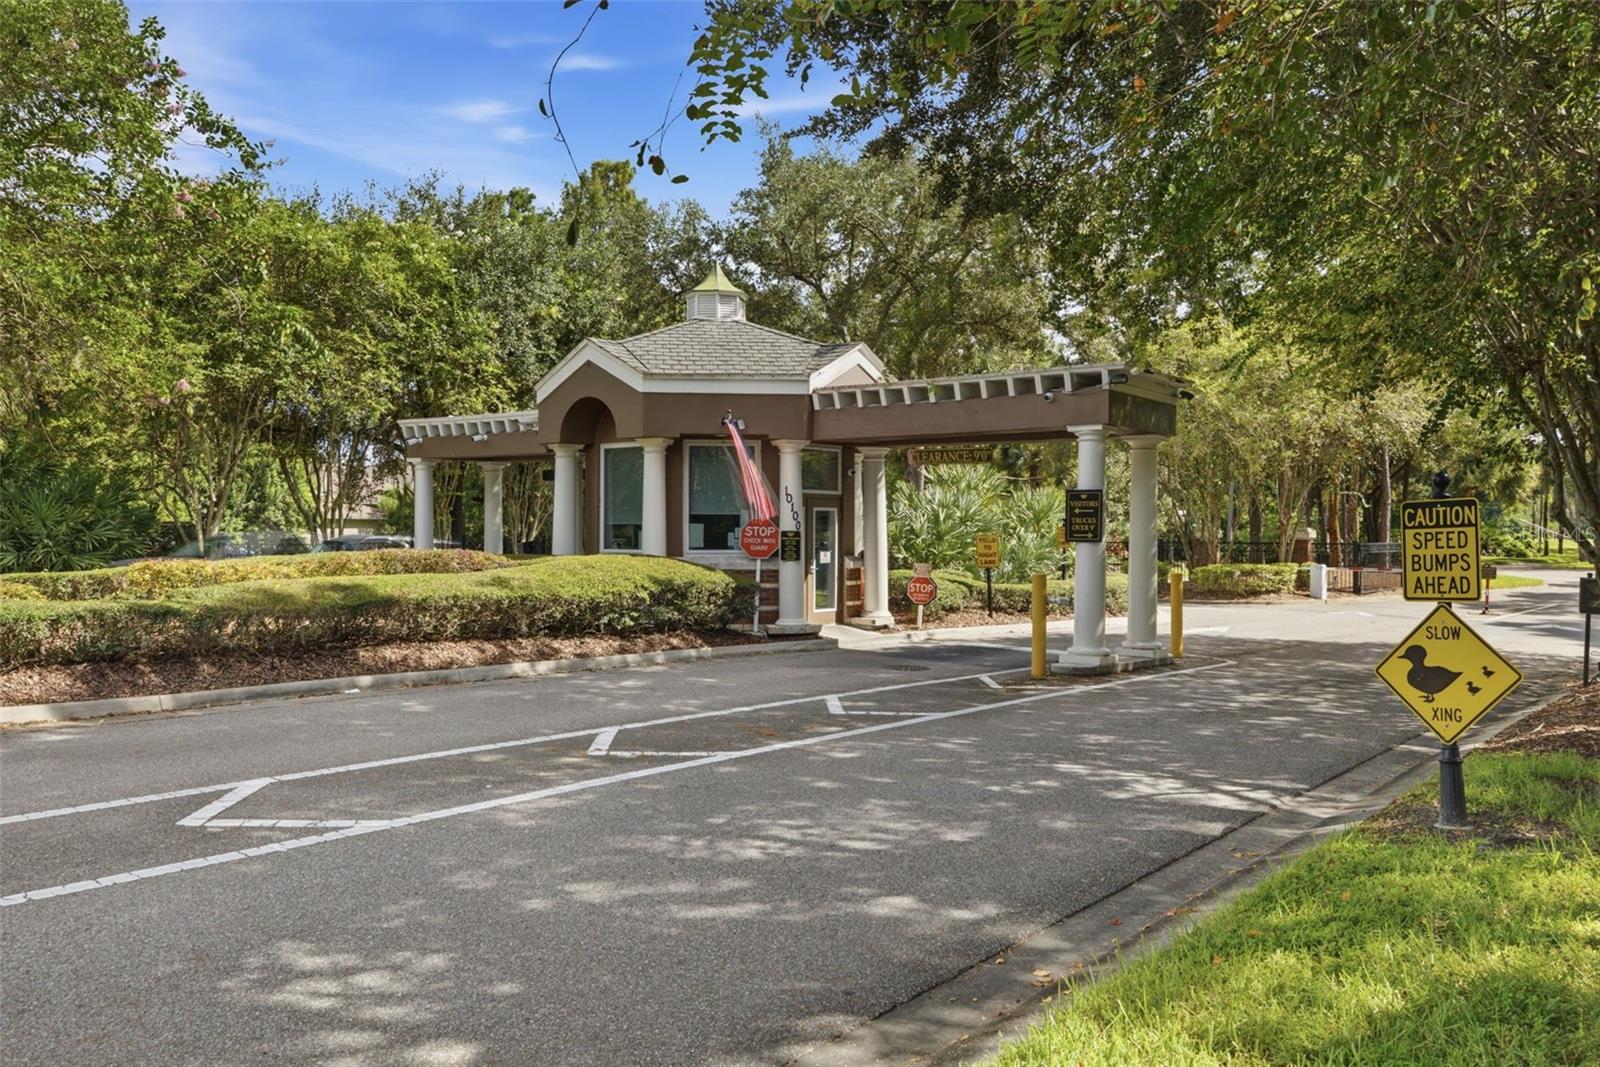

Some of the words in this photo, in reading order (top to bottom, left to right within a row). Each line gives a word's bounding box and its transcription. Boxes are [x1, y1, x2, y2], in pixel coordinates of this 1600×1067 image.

[784, 486, 801, 530] 10100
[1070, 500, 1098, 508] VISITORS
[1404, 505, 1475, 527] CAUTION
[744, 526, 776, 537] STOP
[1412, 530, 1468, 550] SPEED
[1411, 553, 1471, 572] BUMPS
[910, 583, 934, 593] STOP
[1413, 576, 1470, 595] AHEAD
[1425, 626, 1461, 641] SLOW
[1431, 707, 1463, 723] XING
